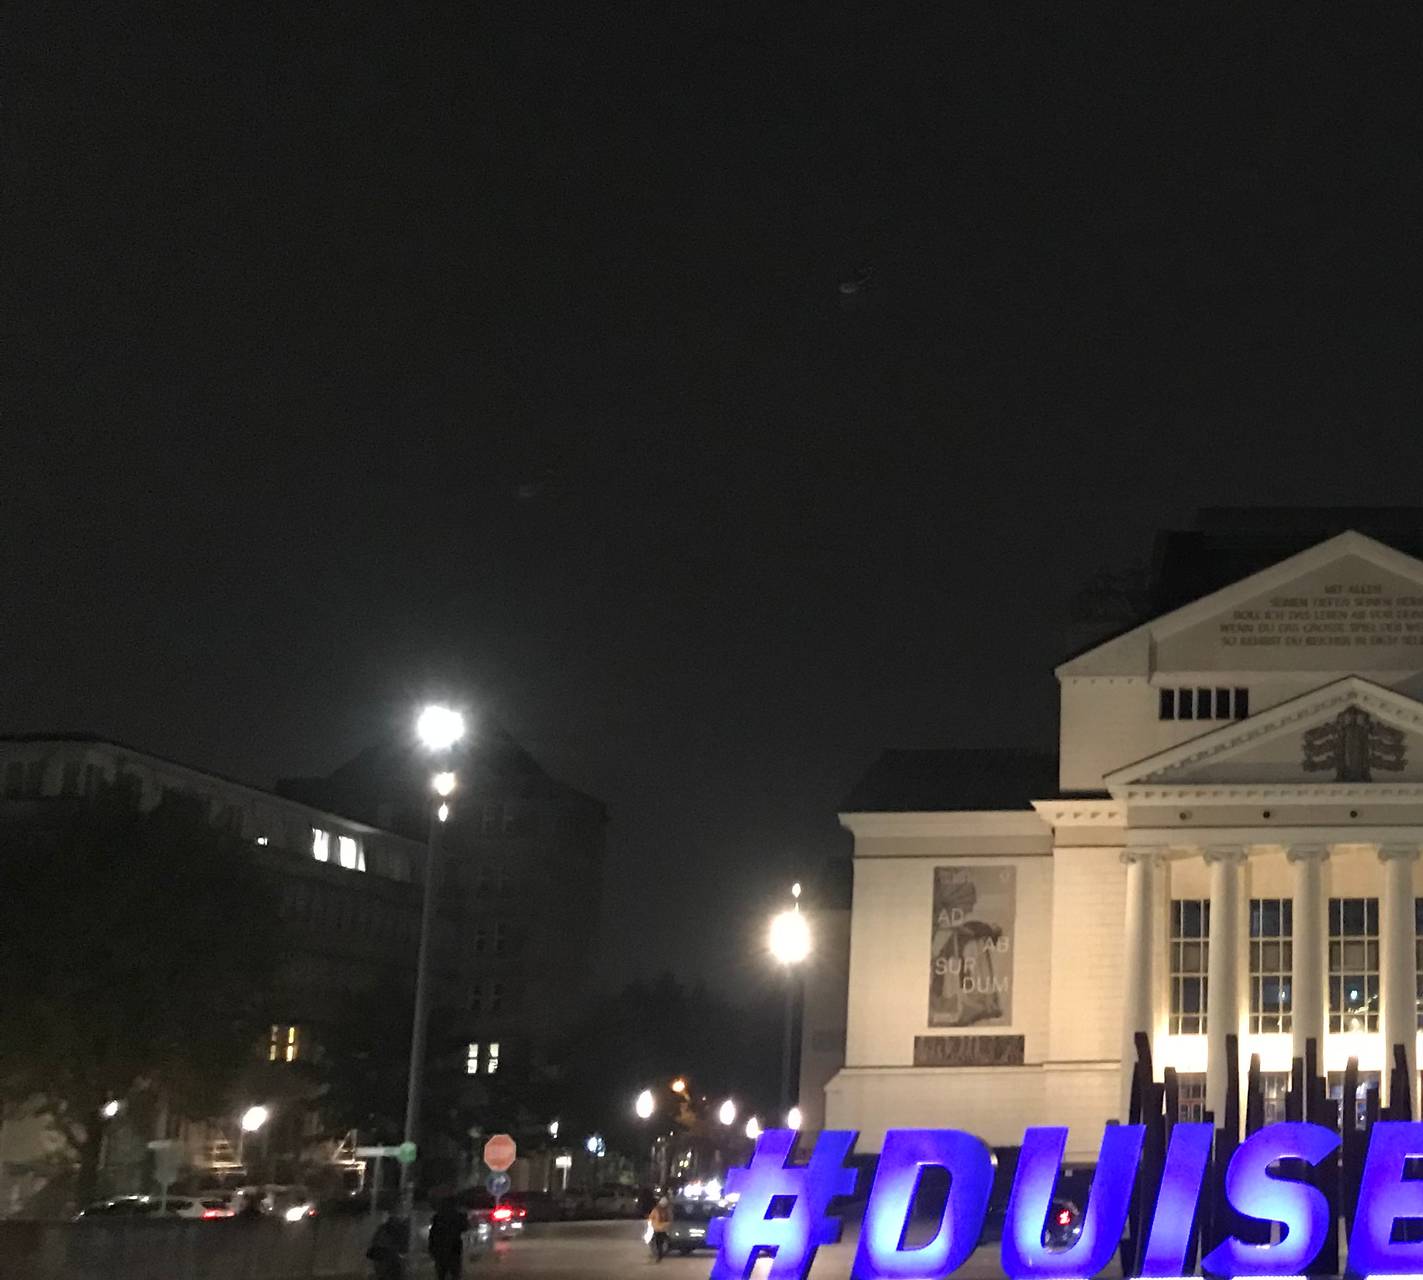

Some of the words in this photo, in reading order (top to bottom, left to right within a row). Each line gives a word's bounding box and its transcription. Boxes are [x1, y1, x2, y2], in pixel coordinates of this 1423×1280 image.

[938, 907, 964, 926] AD
[983, 935, 1010, 952] AB
[935, 957, 976, 976] SUR
[962, 976, 1009, 994] DUM
